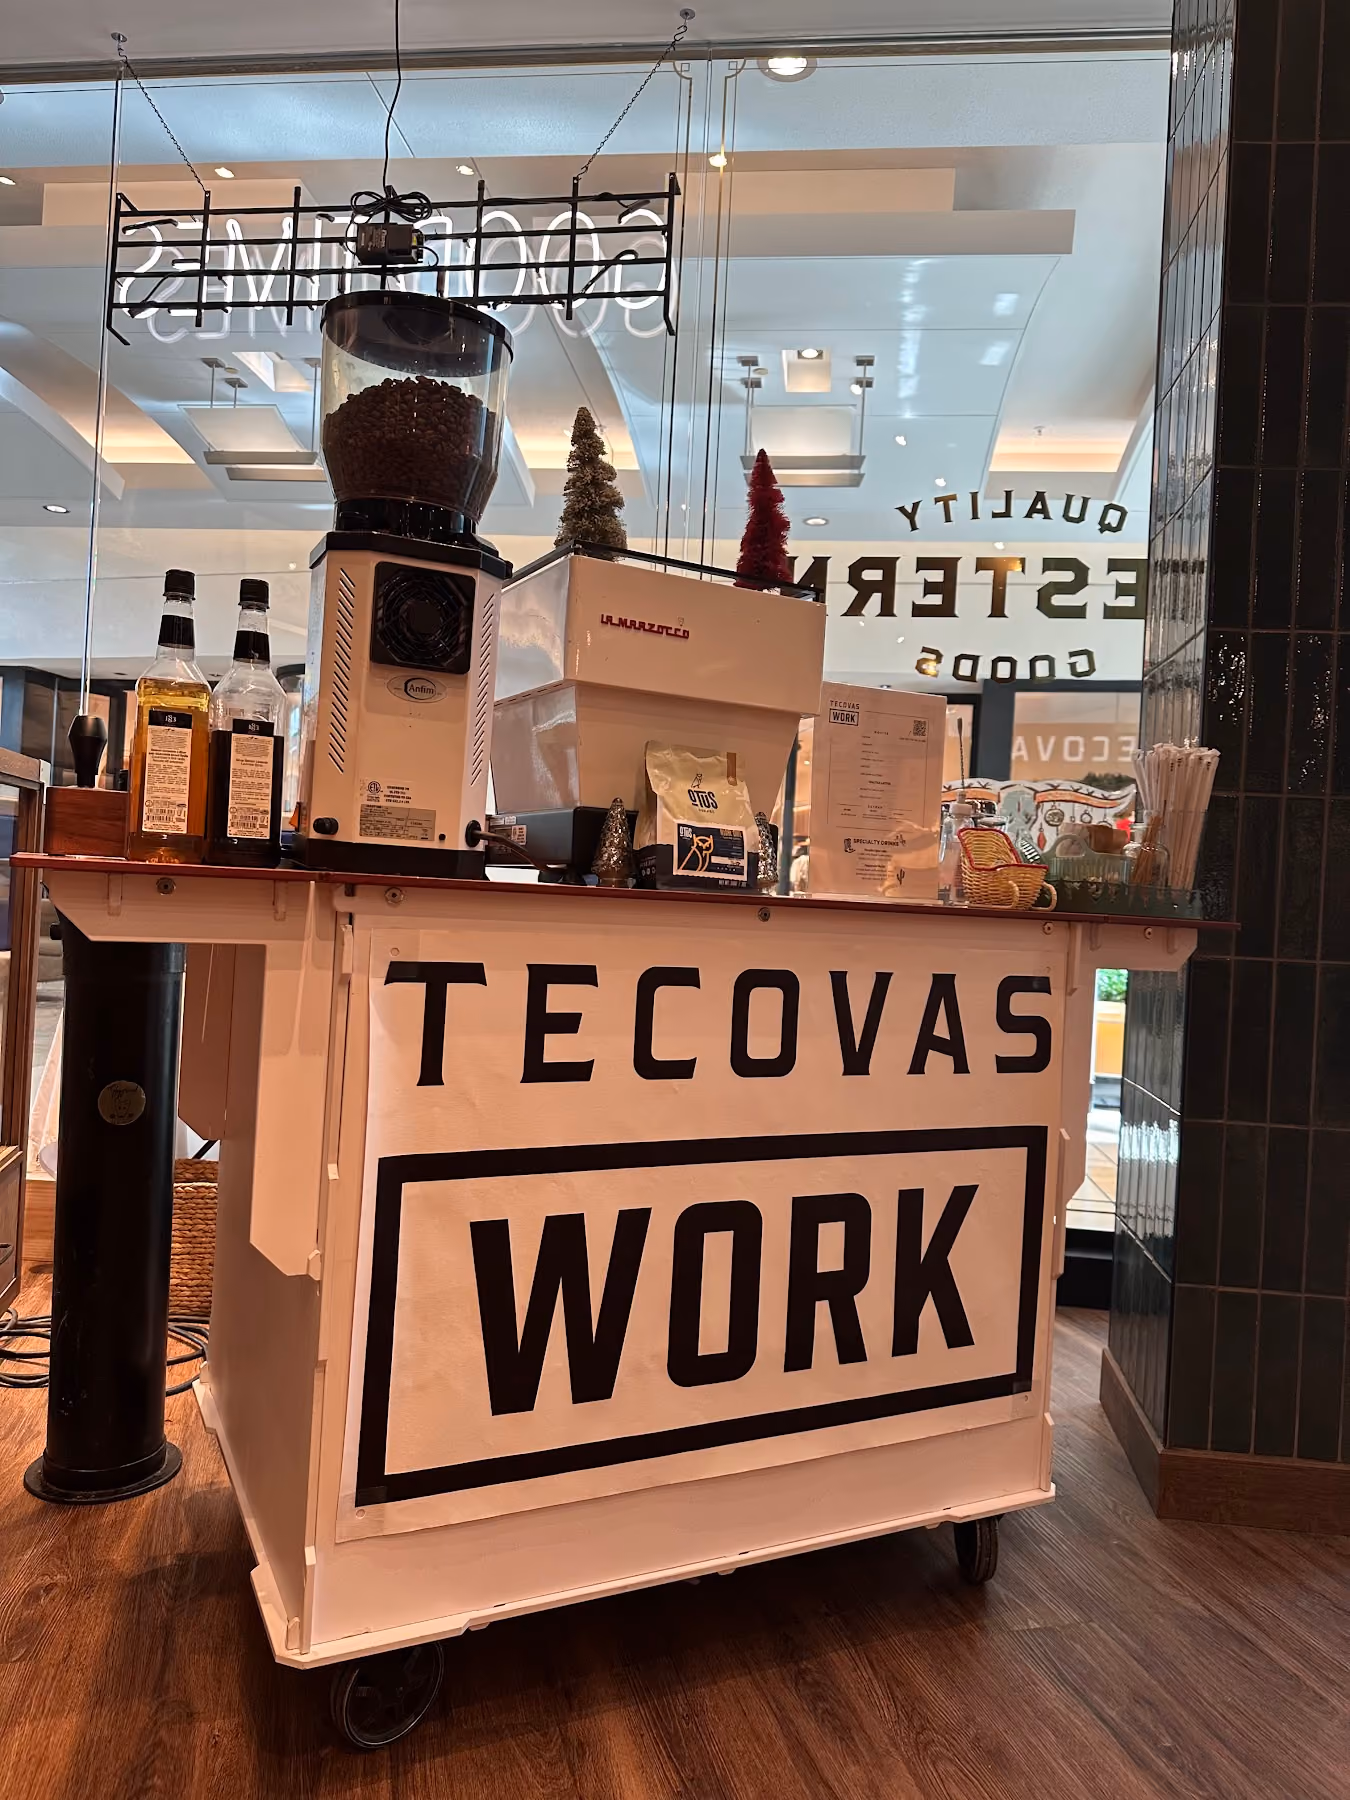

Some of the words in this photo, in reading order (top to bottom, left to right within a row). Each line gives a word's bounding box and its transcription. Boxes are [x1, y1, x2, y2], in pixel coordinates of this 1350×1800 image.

[408, 683, 434, 695] Anfim
[829, 700, 860, 710] TECOVAS
[832, 711, 856, 723] WORK
[687, 788, 718, 810] OTUS
[853, 838, 880, 846] SPECIALTY
[384, 961, 1053, 1087] TECOVAS
[469, 1183, 980, 1417] WORK
